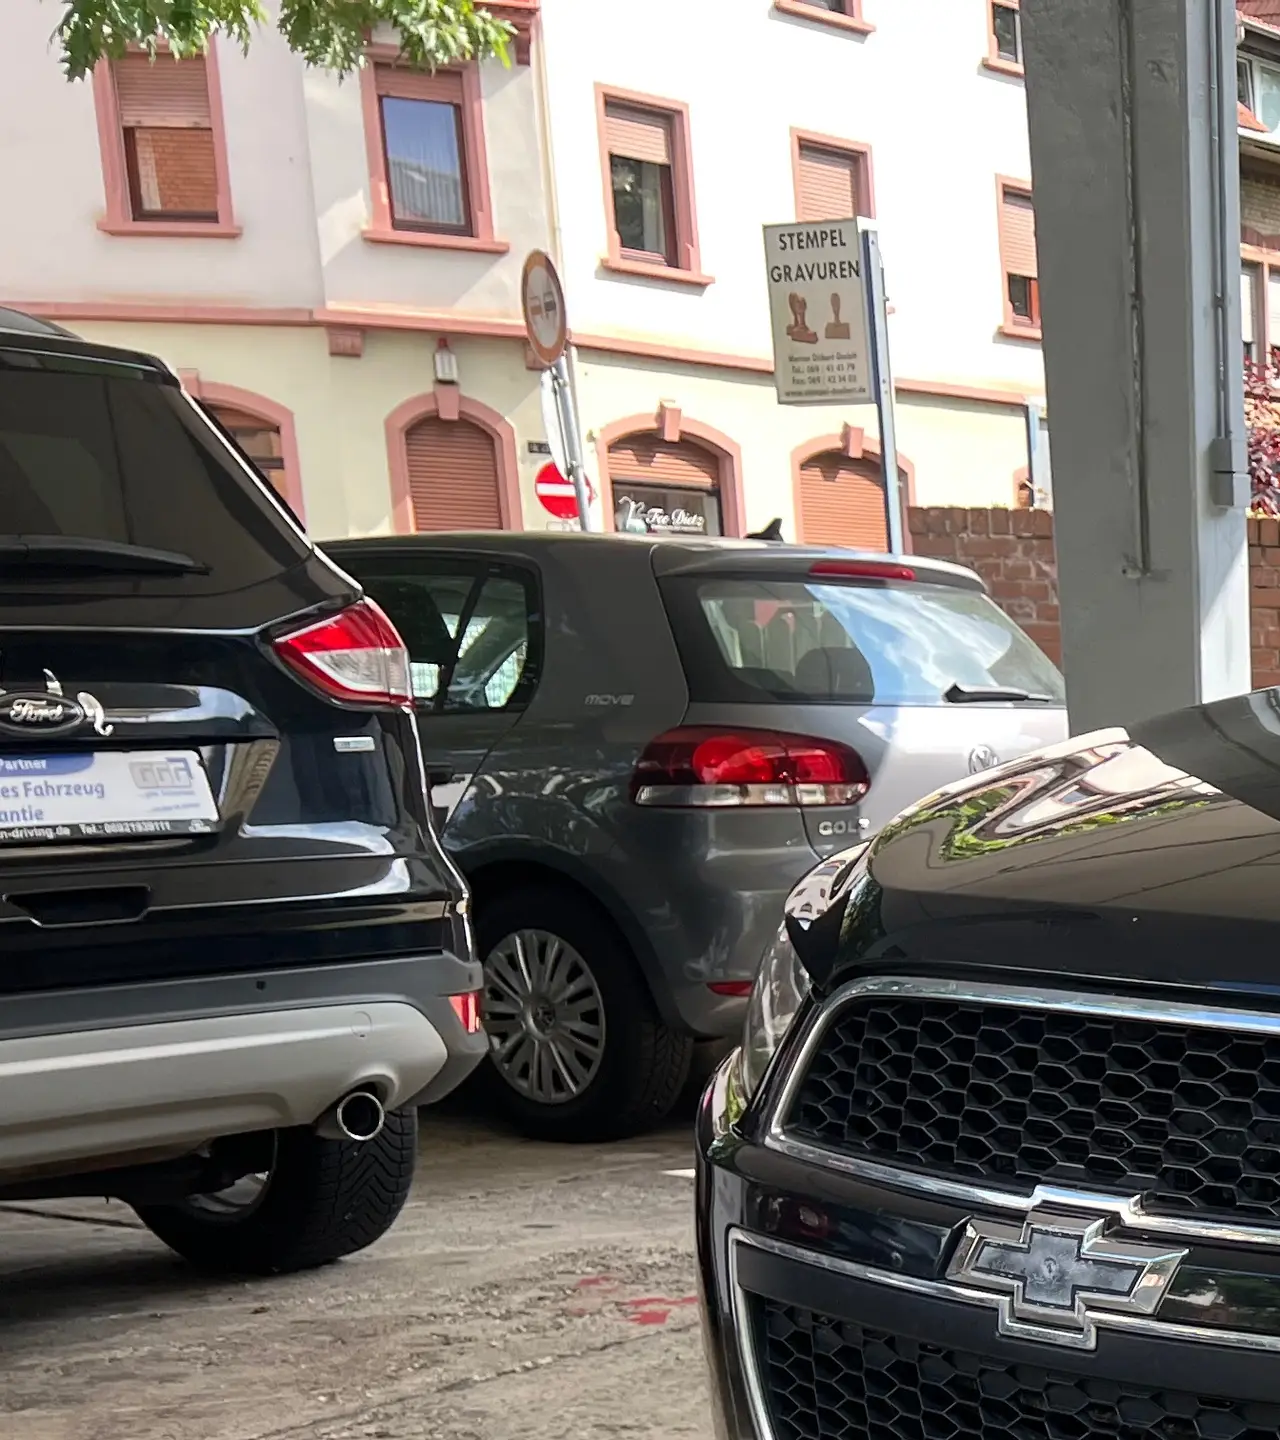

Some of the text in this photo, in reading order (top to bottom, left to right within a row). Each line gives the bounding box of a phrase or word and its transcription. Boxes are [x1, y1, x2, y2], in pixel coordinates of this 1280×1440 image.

[778, 229, 847, 251] STEMPEL
[771, 260, 860, 283] GRAVUREN
[9, 699, 64, 722] Ford
[0, 758, 47, 770] artner
[22, 780, 105, 799] Fahrzeug
[0, 804, 44, 822] antie
[819, 818, 870, 836] GOL
